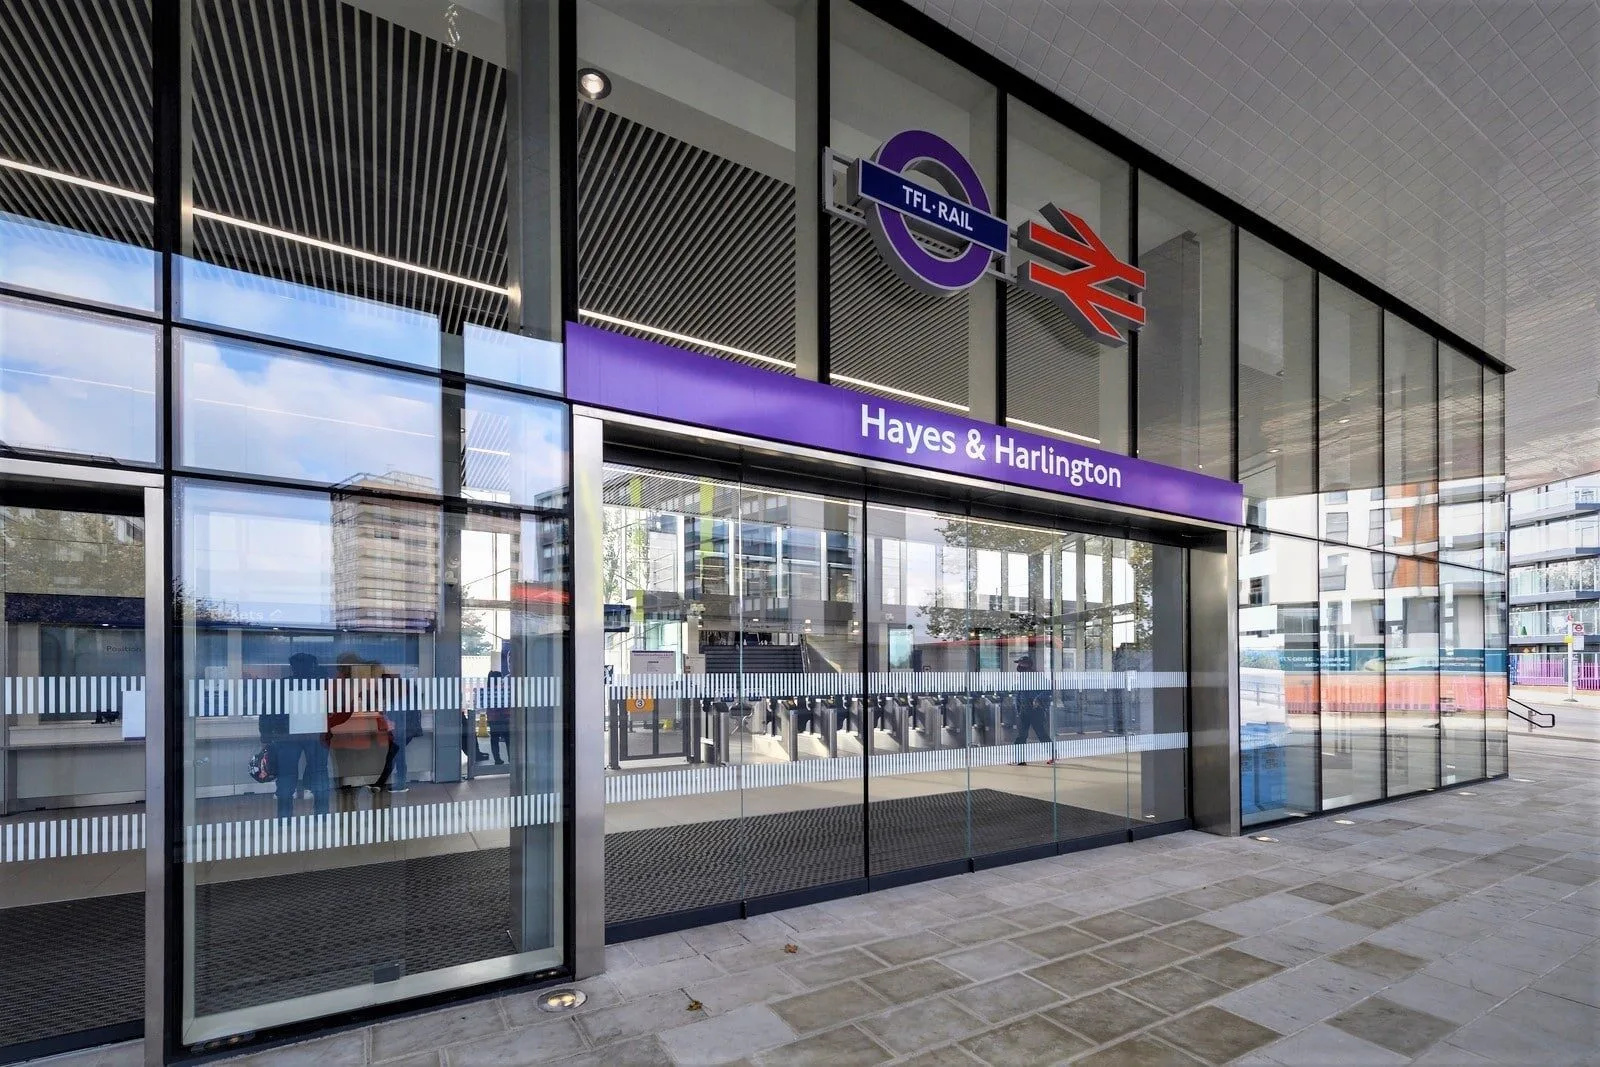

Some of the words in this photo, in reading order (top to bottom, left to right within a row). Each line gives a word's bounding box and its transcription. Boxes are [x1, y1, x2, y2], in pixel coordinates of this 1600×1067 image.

[861, 403, 957, 455] Hayes
[965, 428, 986, 461] &
[995, 434, 1121, 488] Harlington
